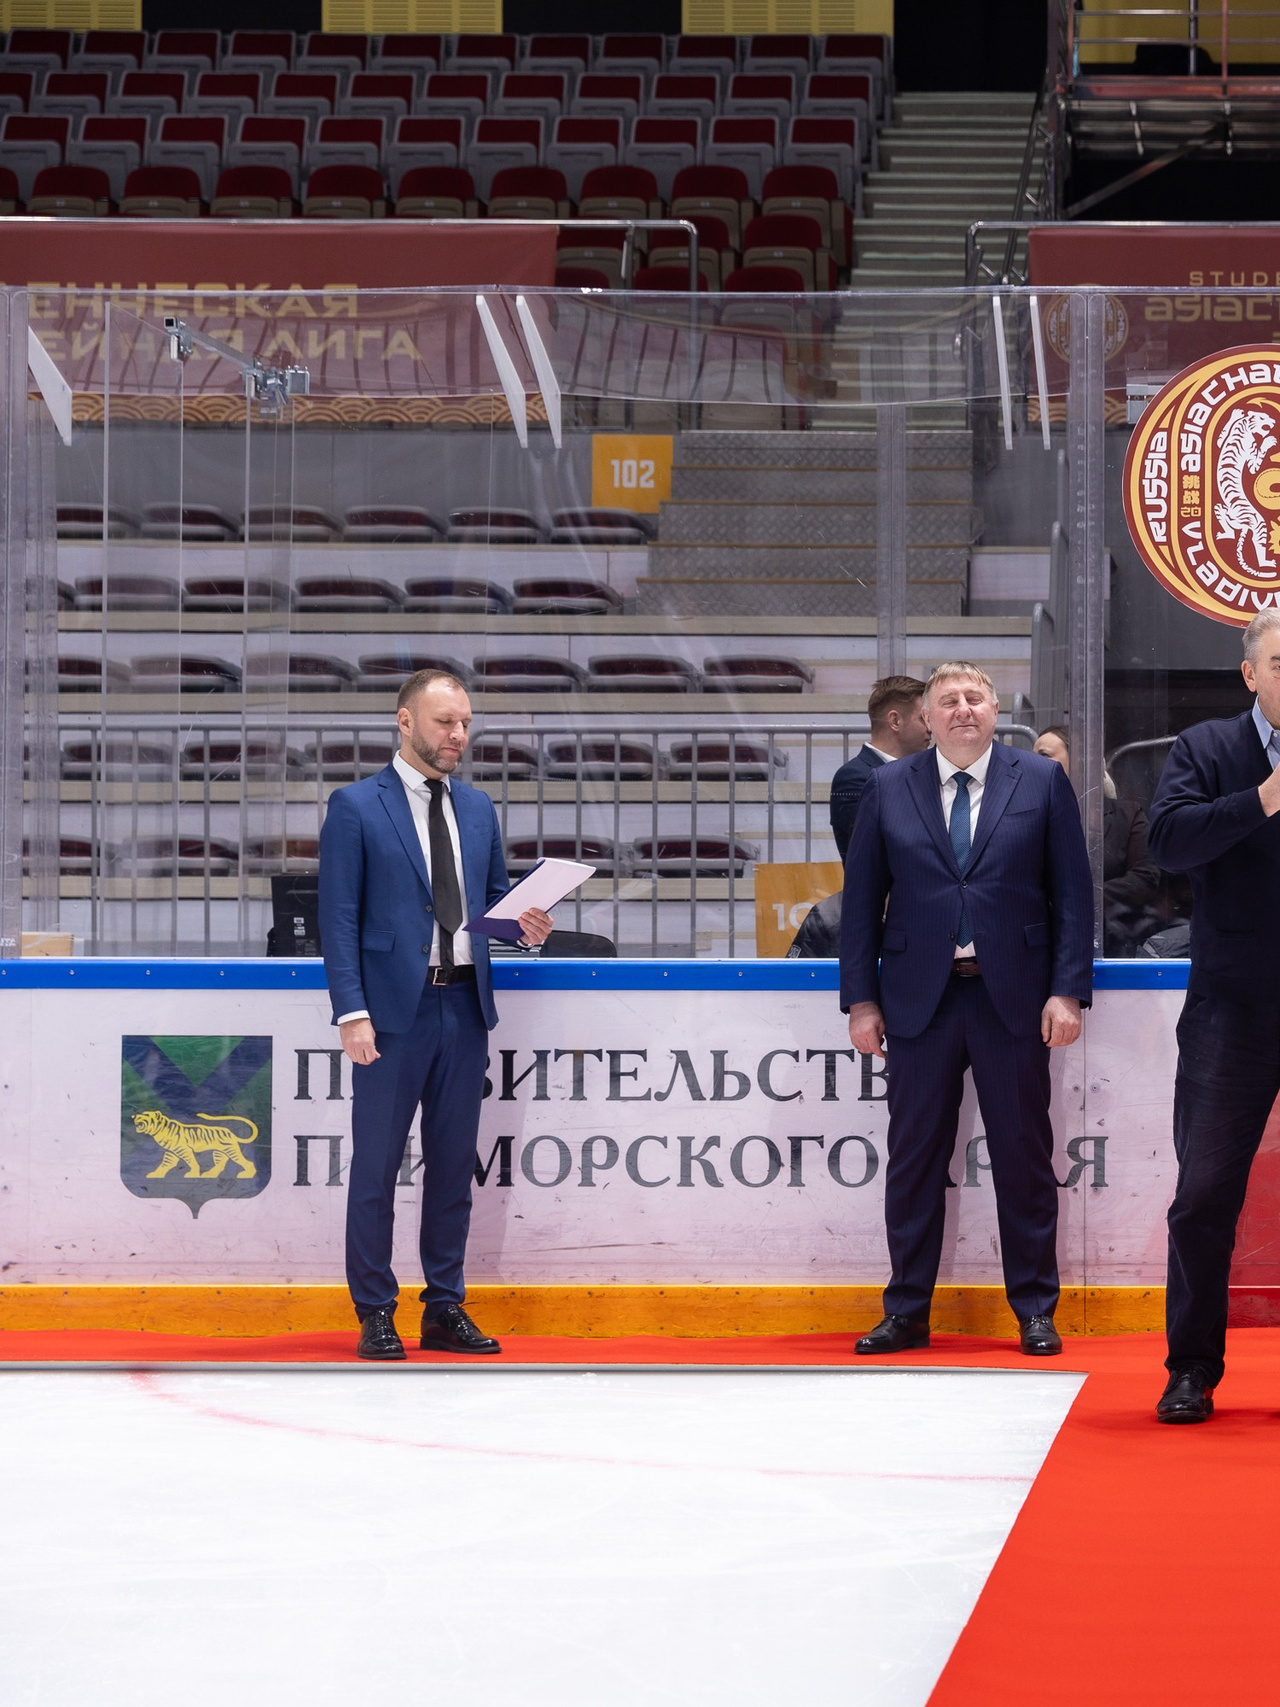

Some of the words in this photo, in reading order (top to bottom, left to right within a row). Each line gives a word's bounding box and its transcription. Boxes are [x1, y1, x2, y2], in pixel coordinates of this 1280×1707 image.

[0, 281, 359, 318] ЕНЧЕСКАЯ
[264, 330, 421, 361] ЛИГА
[611, 459, 655, 488] 102
[1142, 431, 1168, 542] RUSSIA
[293, 1134, 879, 1188] ПМОРСКОГО
